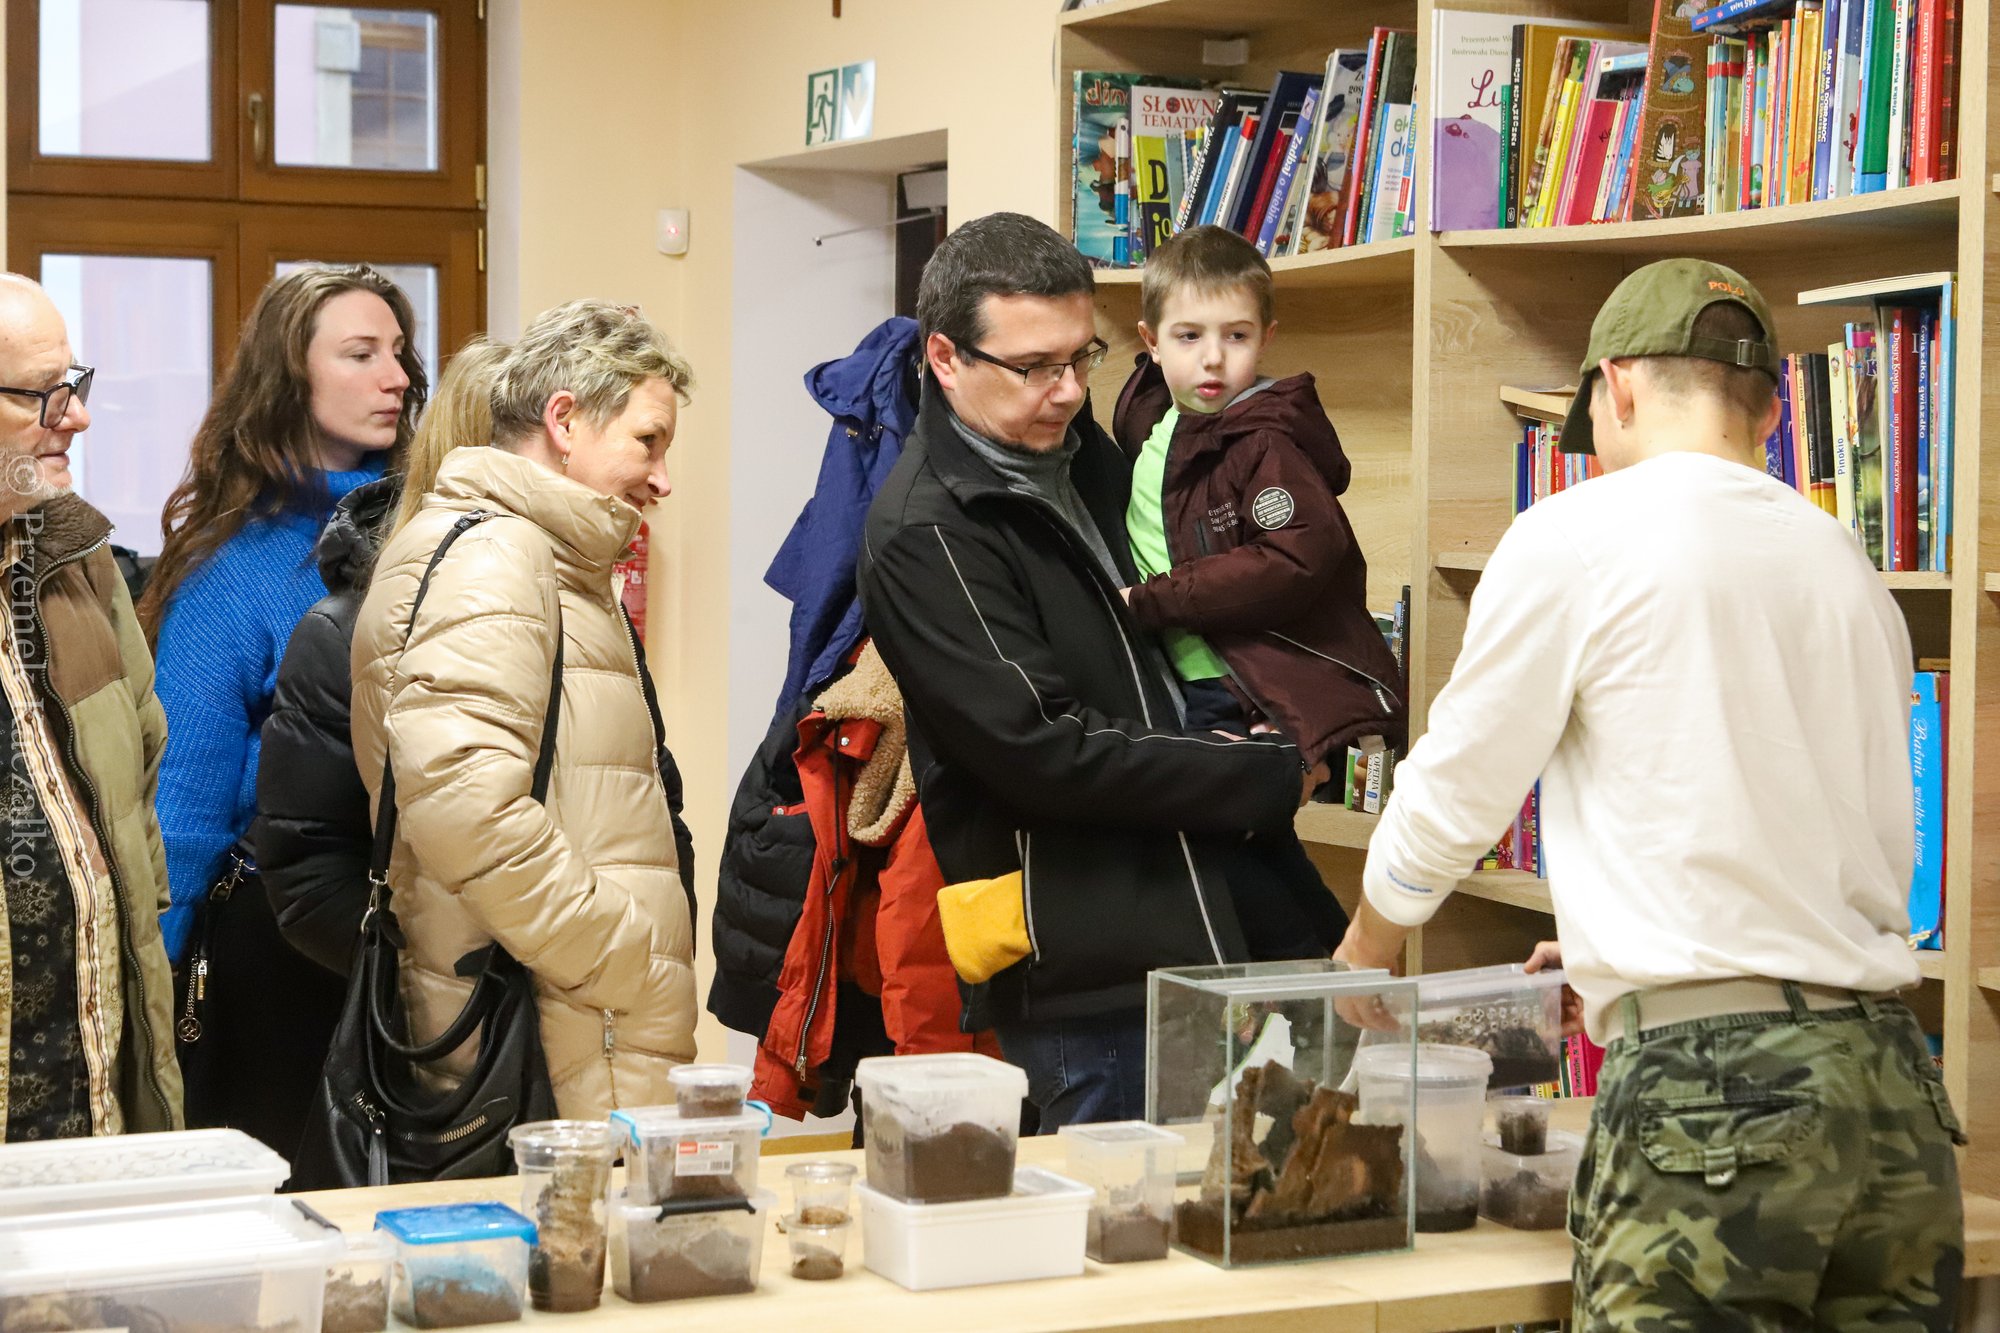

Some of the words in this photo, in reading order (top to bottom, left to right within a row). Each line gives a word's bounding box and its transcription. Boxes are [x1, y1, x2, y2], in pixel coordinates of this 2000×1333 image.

[1922, 12, 1930, 43] DZIECI
[1489, 48, 1509, 56] Diana
[1893, 52, 1901, 83] Księga
[1825, 76, 1832, 91] NA
[1891, 85, 1899, 116] Wielka
[1920, 66, 1928, 114] NIEMIECKI
[1821, 92, 1831, 143] DOBRANOC
[1203, 126, 1216, 155] TAJNE
[1281, 132, 1304, 178] Zadbaj
[1266, 189, 1284, 224] siebie
[1708, 281, 1745, 298] POLO
[1920, 324, 1928, 382] Gwiazdko,
[1918, 386, 1927, 439] gwiazdko
[1837, 437, 1847, 475] Pinokio
[1913, 717, 1929, 778] Baśnie
[1371, 754, 1382, 791] OPEDIA
[1914, 786, 1926, 827] wielka
[1915, 828, 1926, 867] księga
